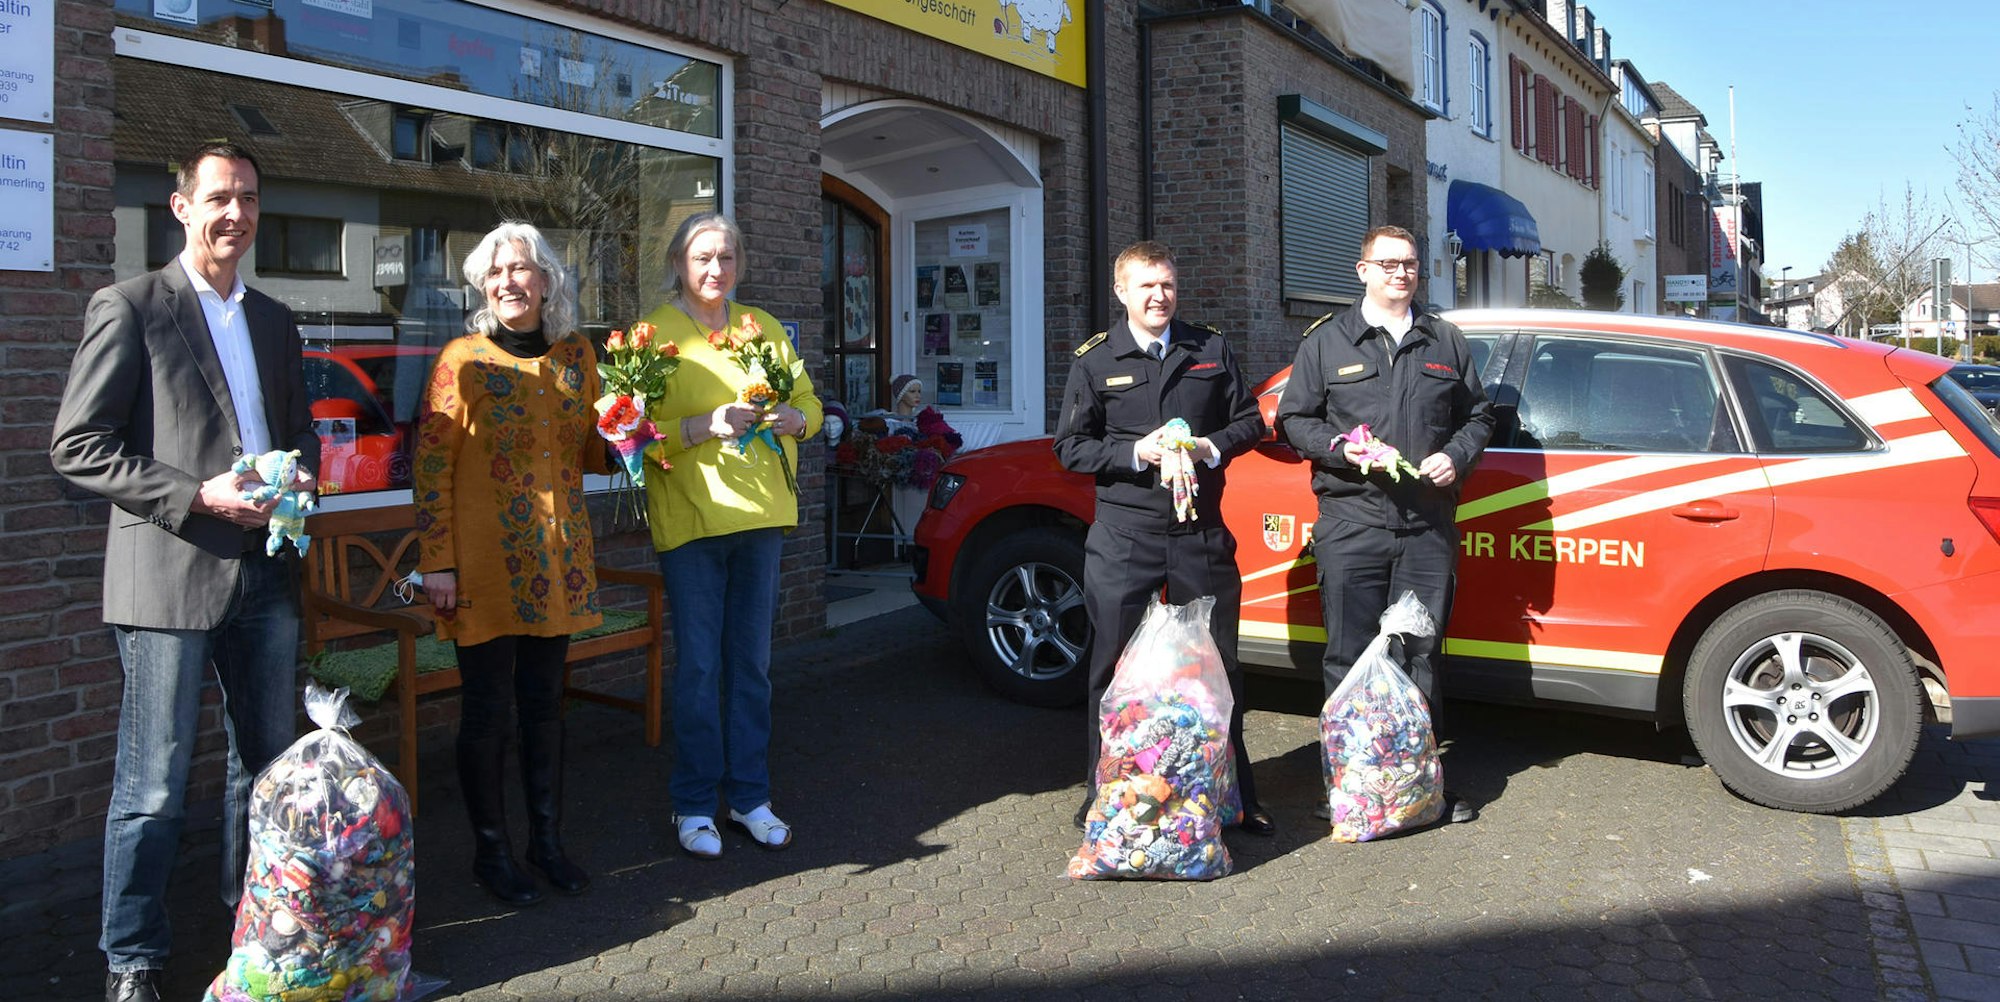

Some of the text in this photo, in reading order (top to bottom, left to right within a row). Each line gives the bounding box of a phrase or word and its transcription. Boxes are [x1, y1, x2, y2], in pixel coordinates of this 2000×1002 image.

[906, 0, 976, 26] geschäft
[0, 178, 45, 192] merling
[0, 229, 32, 241] arung
[1509, 533, 1645, 568] KERPEN
